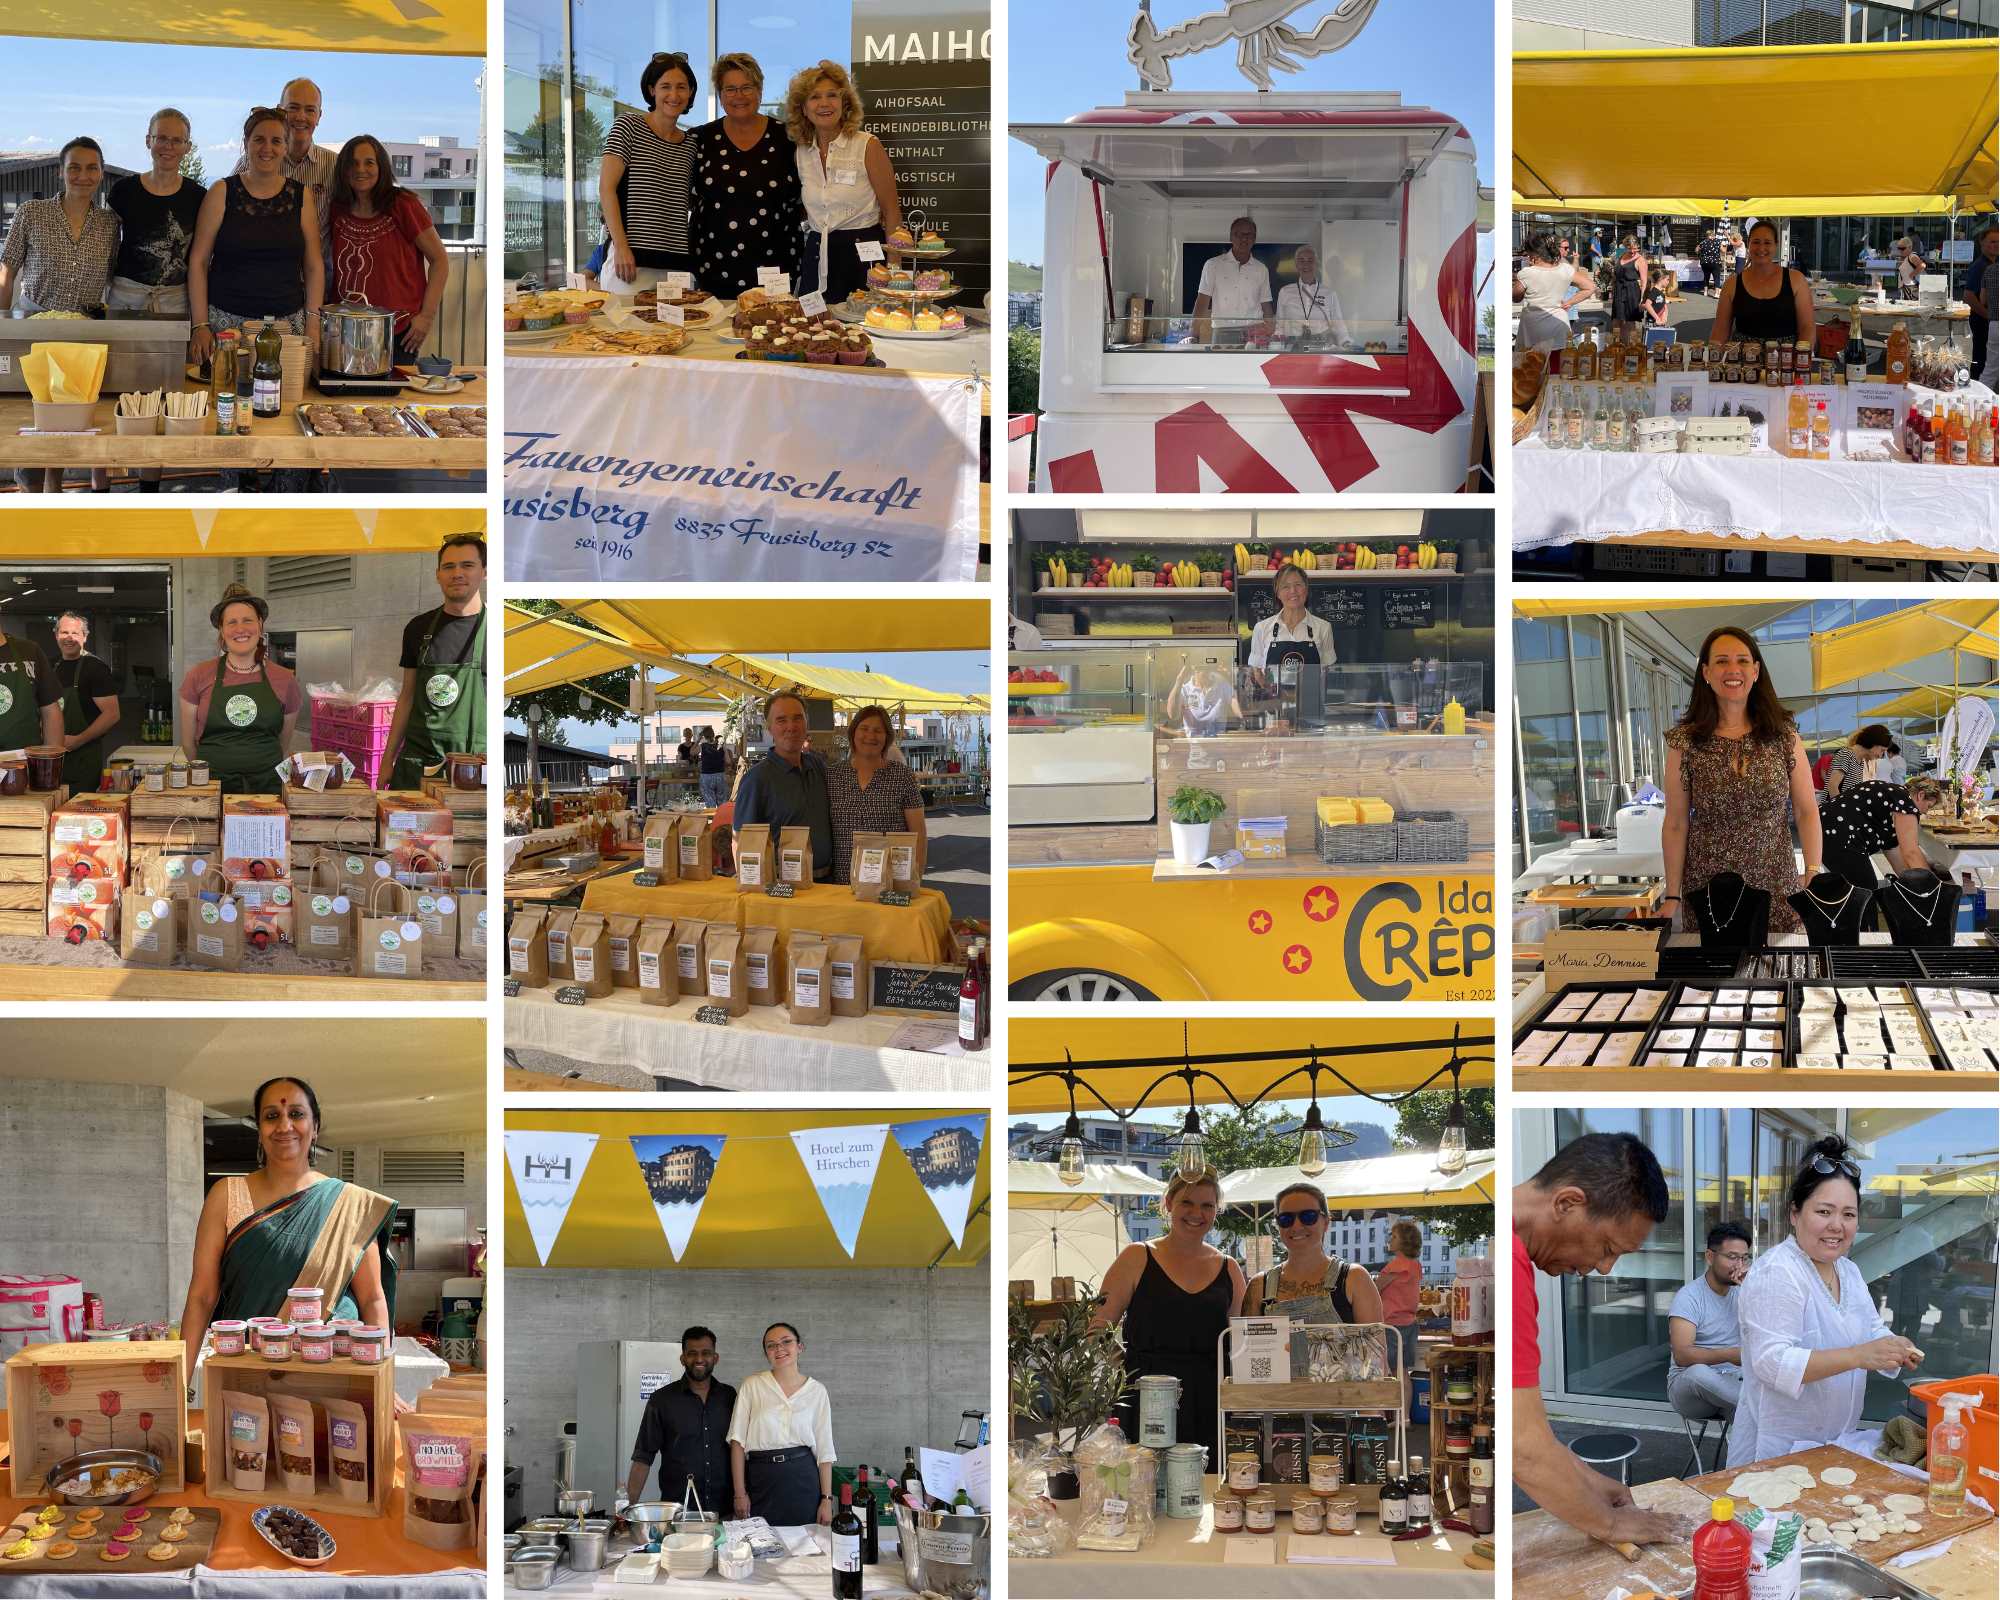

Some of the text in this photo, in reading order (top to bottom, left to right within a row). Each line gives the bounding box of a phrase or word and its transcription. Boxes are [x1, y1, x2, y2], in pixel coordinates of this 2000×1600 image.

[730, 518, 857, 560] Feusisberg
[601, 540, 633, 561] 1916
[1593, 952, 1648, 968] Dennise
[1446, 989, 1465, 1001] Est
[811, 1142, 873, 1156] Hotel zum
[816, 1156, 870, 1171] Hirschen
